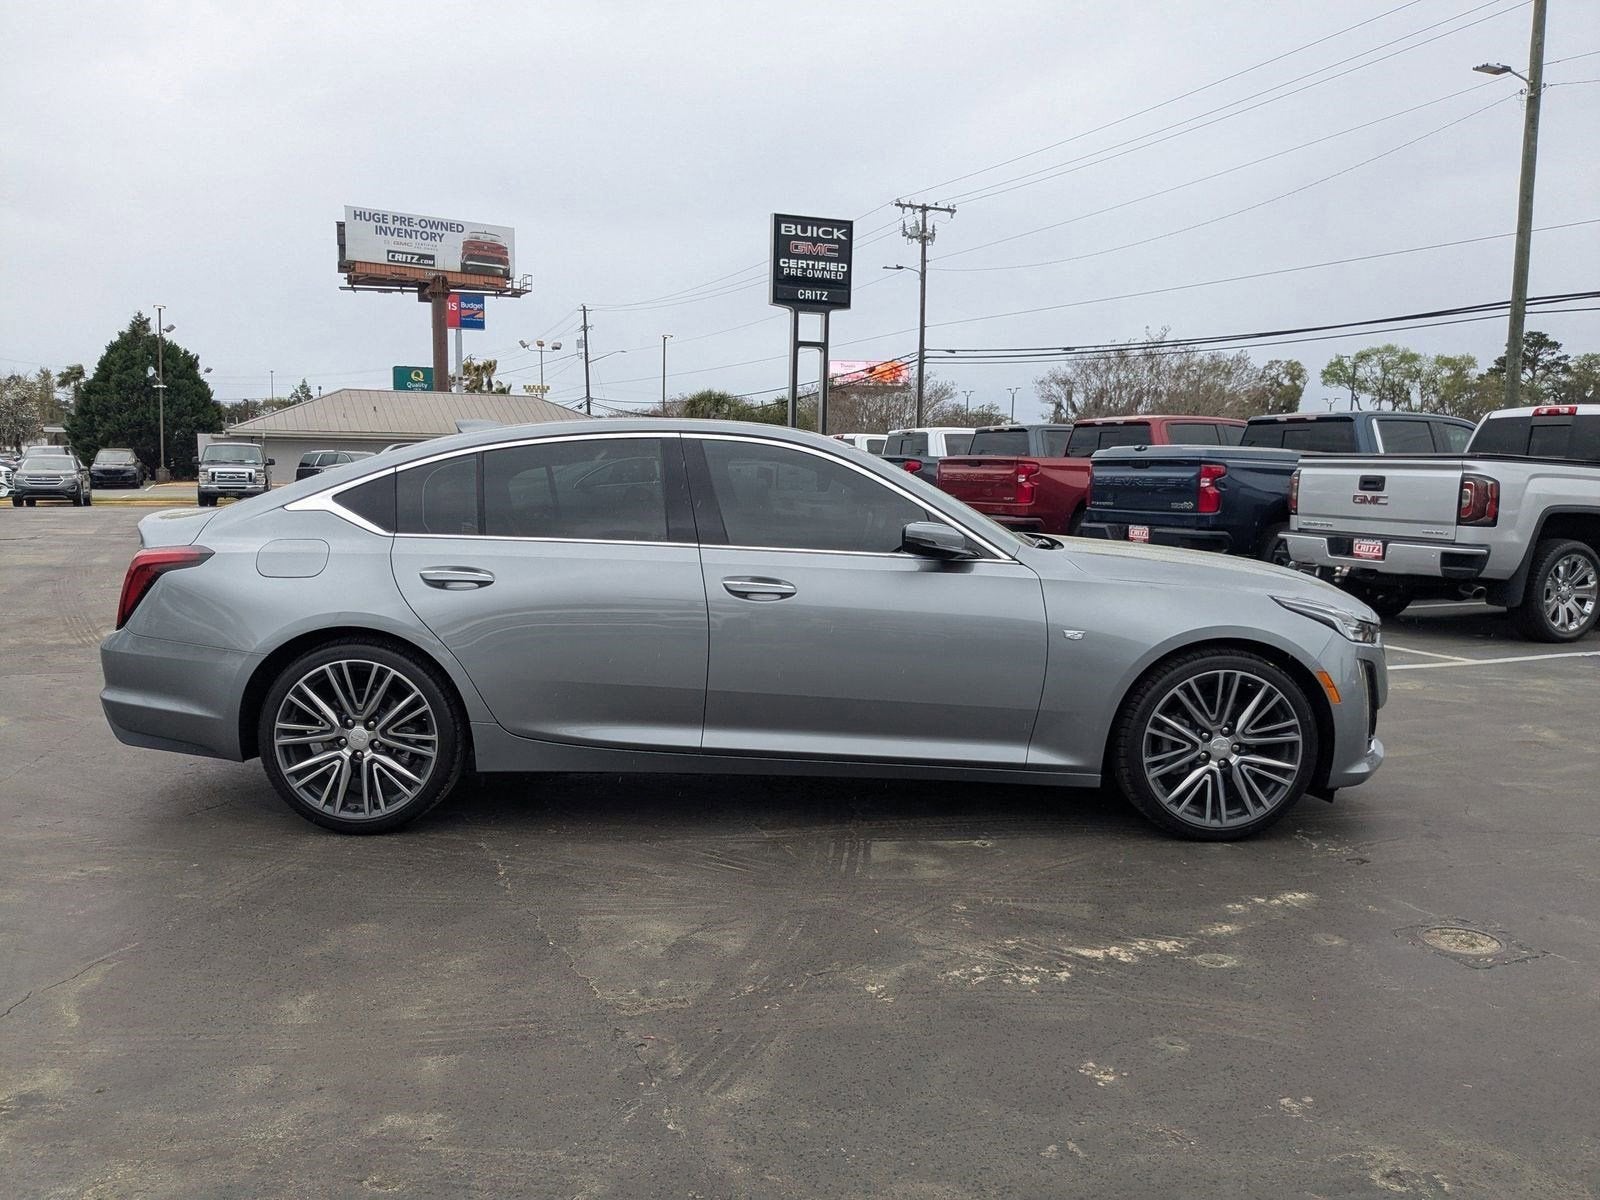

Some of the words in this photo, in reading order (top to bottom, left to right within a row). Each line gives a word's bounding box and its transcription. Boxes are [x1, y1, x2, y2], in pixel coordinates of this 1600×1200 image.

[353, 210, 389, 225] HUGE
[392, 215, 465, 234] PRE-OWNED
[375, 225, 445, 243] INVENTORY
[780, 223, 848, 240] BUICK
[789, 240, 839, 257] GMC
[779, 258, 848, 272] CERTIFIED
[783, 268, 844, 280] PRE-OWNED
[797, 289, 829, 301] CRITZ
[460, 301, 484, 311] Budget
[406, 381, 428, 389] Quality
[1352, 495, 1389, 506] GMC
[1355, 543, 1380, 553] CRITZ
